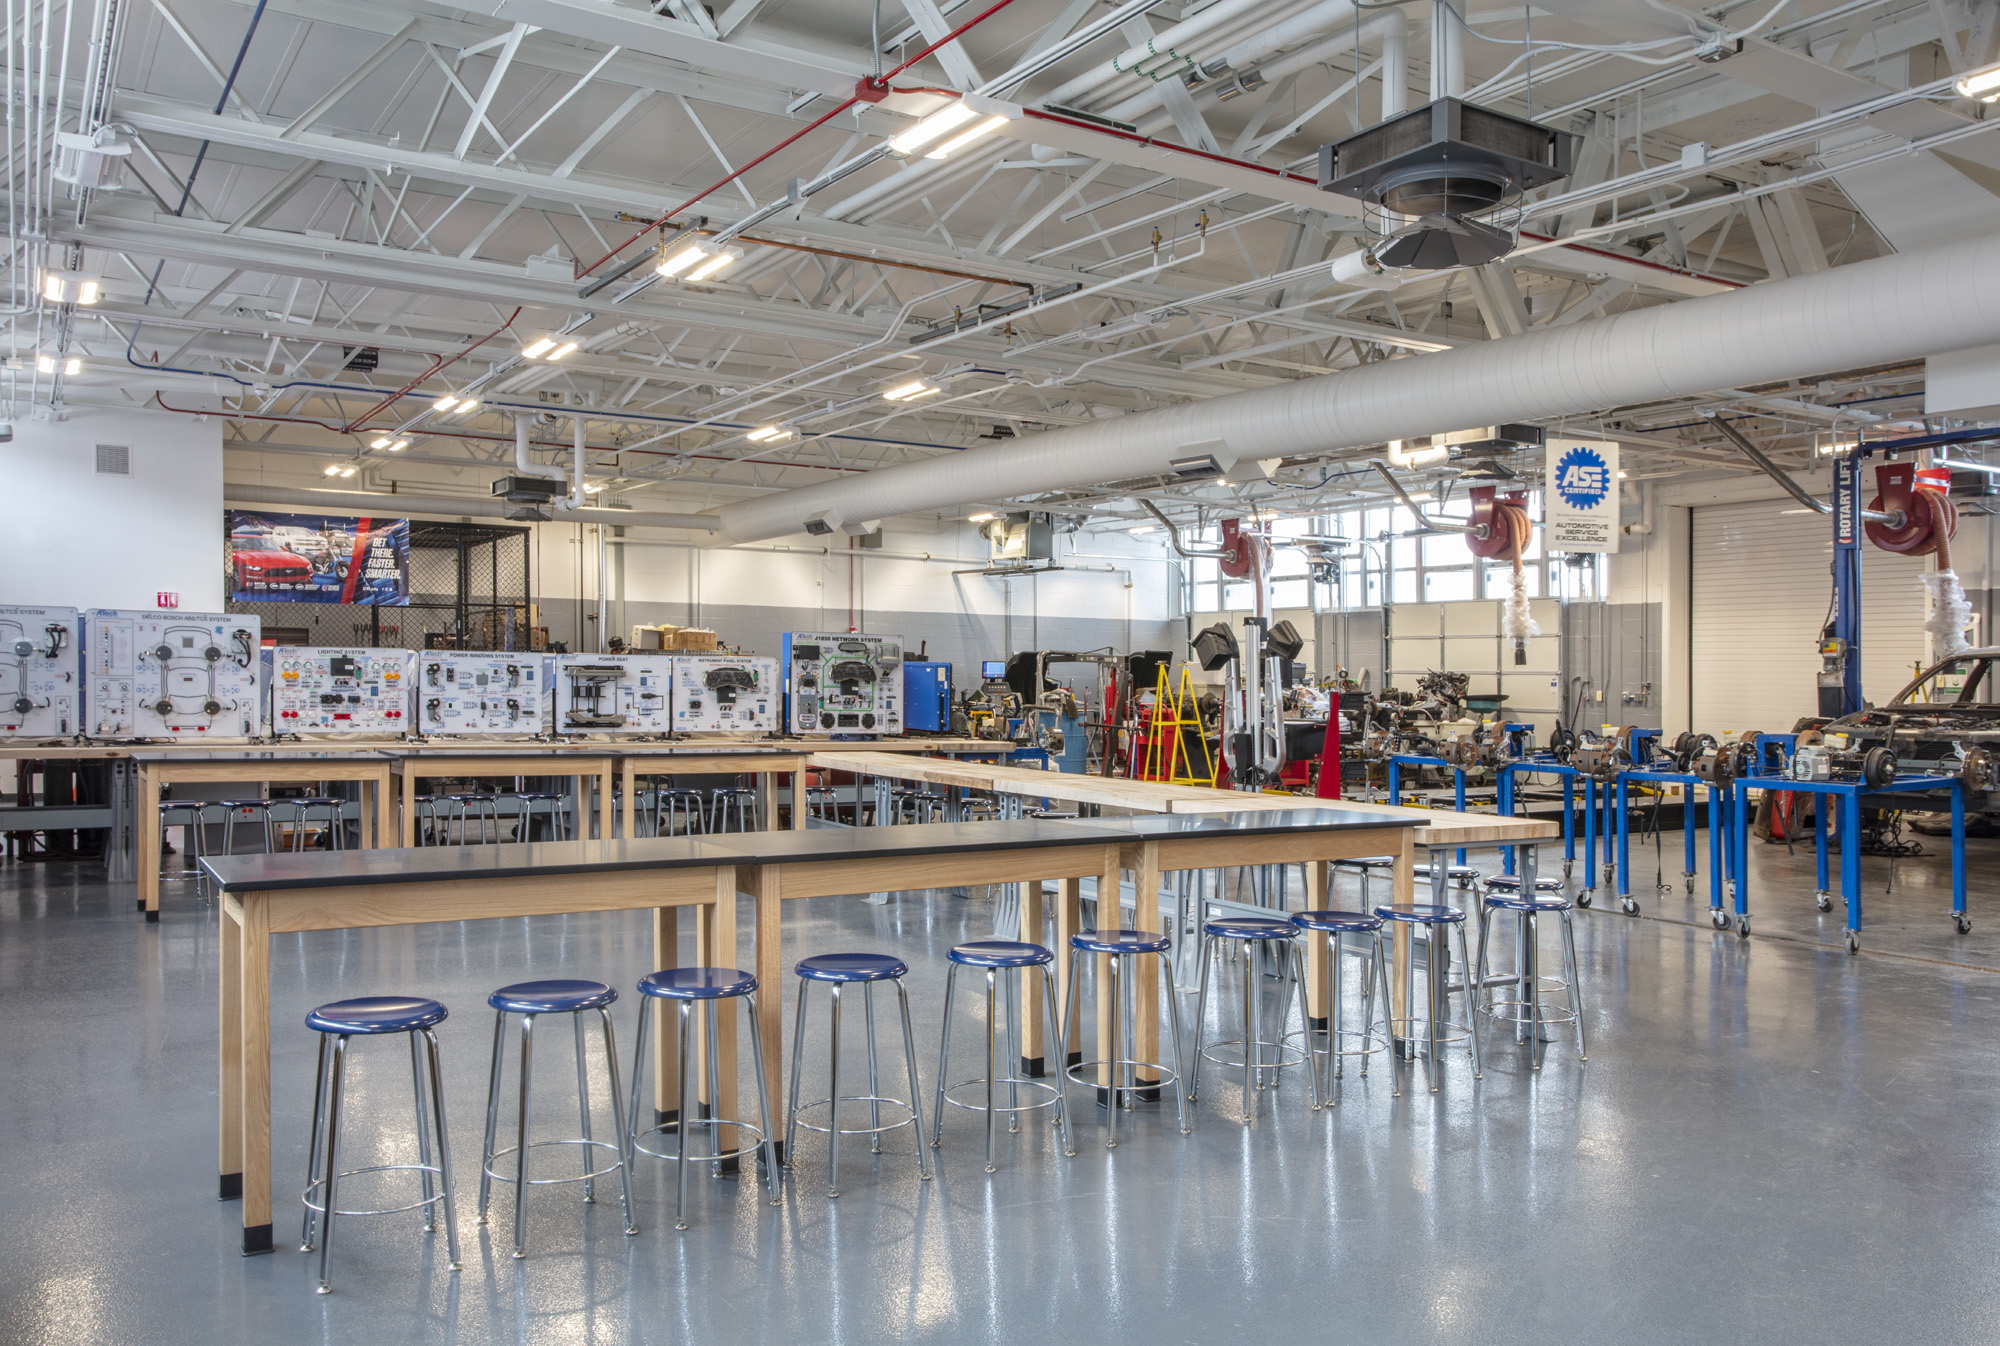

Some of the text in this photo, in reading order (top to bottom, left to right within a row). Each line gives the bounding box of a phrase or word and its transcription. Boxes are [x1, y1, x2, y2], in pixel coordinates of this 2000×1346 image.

[1561, 465, 1602, 488] ASE
[1564, 487, 1602, 495] CERTIFIED
[1839, 459, 1851, 537] ROTARY LIFT
[1555, 522, 1609, 530] AUTOMOTIVE
[372, 537, 388, 548] GET
[370, 547, 394, 558] THERE.
[367, 558, 395, 569] FASTER.
[365, 568, 401, 579] SMARTER.
